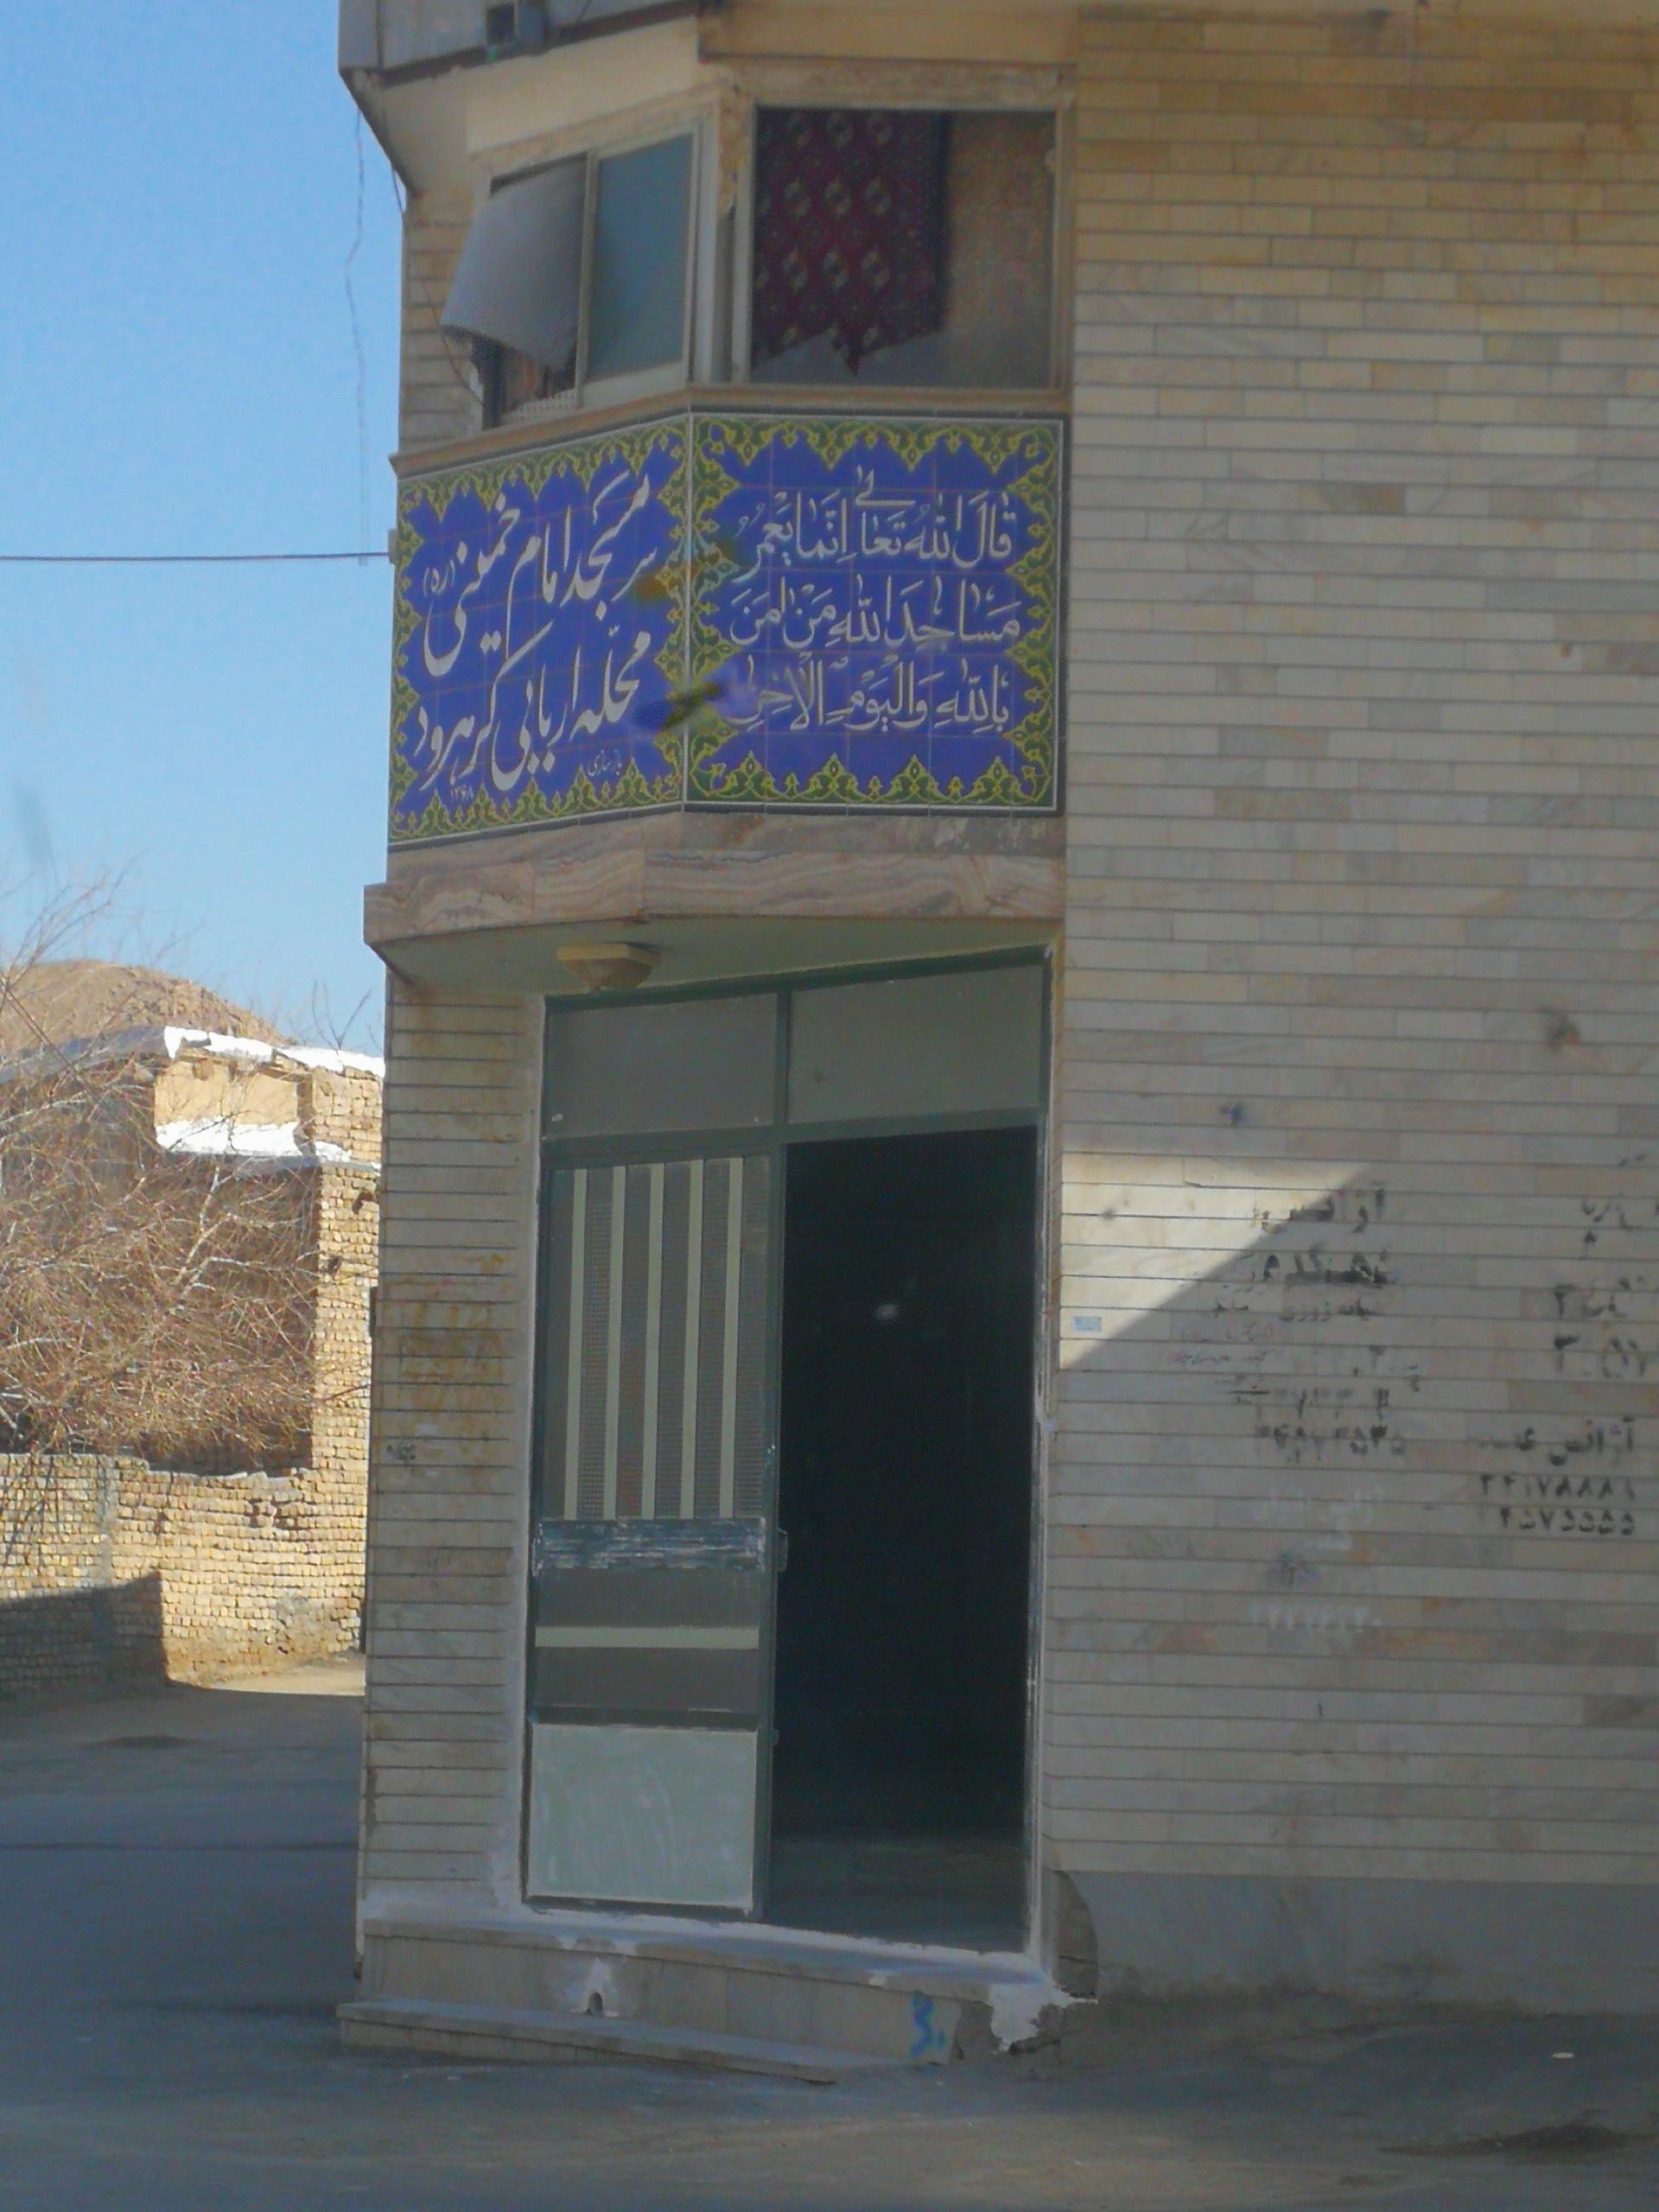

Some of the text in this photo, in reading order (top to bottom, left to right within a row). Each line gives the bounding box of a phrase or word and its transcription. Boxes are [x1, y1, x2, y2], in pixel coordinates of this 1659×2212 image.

[424, 492, 520, 677] خمینی
[505, 505, 571, 658] امام
[560, 469, 655, 621] مسجد
